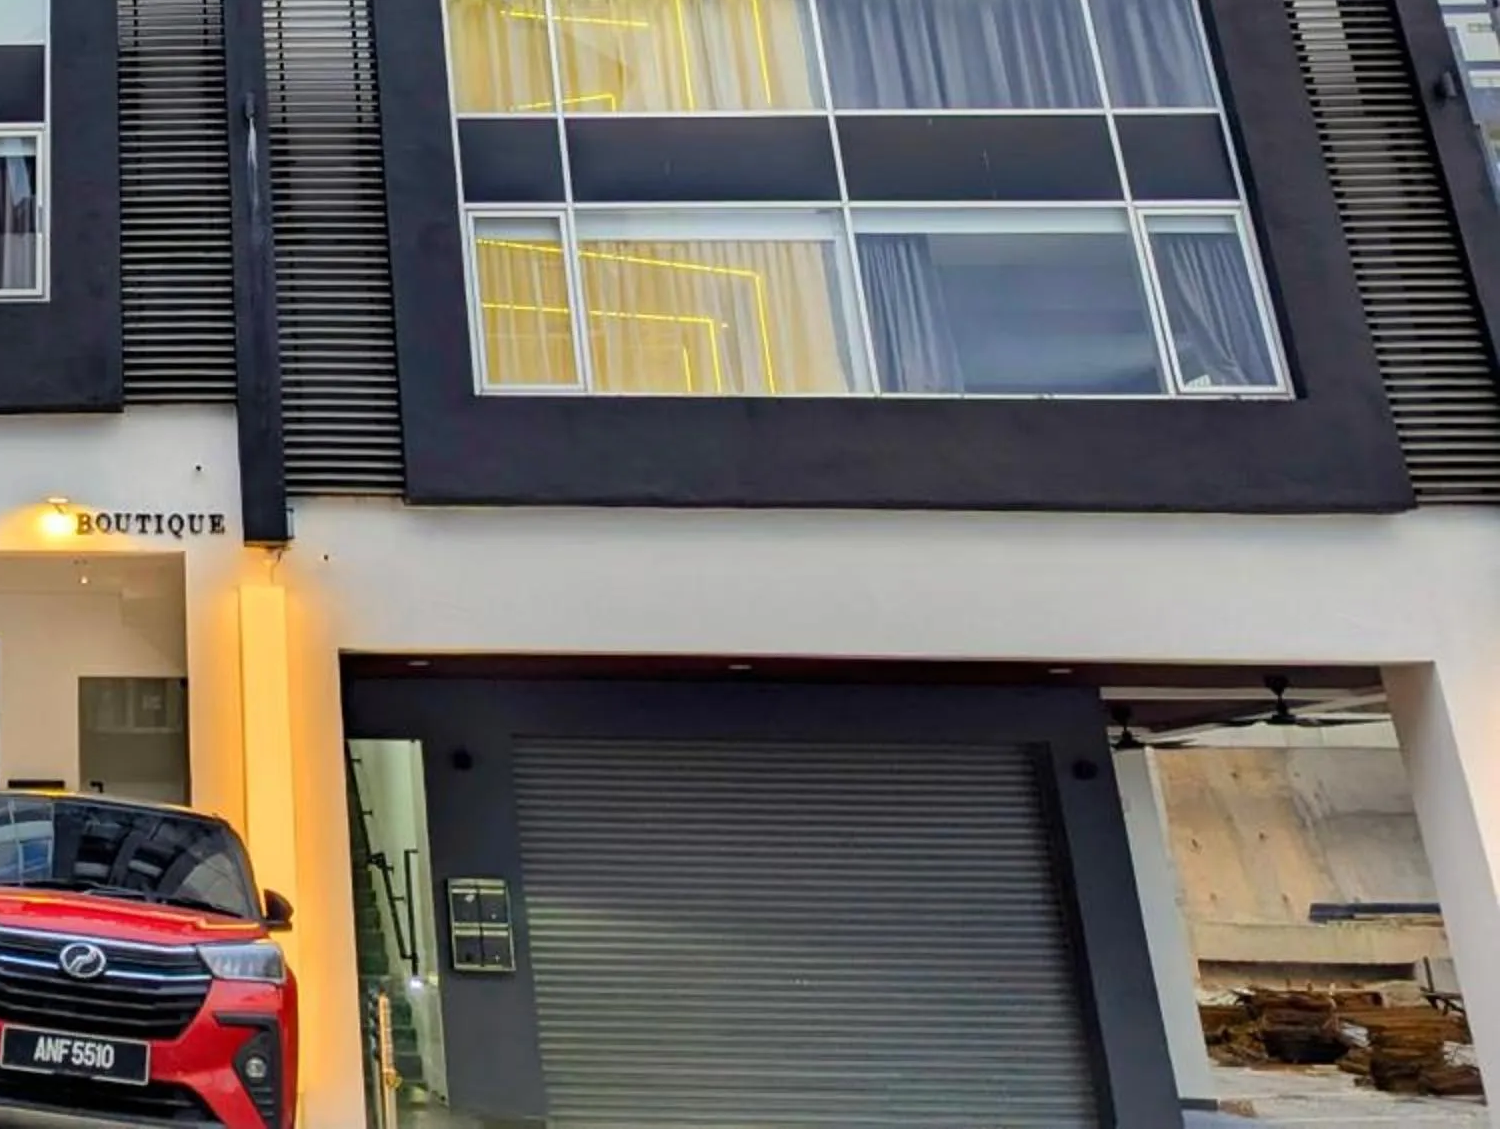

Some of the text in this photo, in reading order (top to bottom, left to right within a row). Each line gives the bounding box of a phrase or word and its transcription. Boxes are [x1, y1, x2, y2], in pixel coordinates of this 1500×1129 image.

[76, 512, 225, 539] BOUTIQUE
[33, 1035, 115, 1069] ANF 5510
